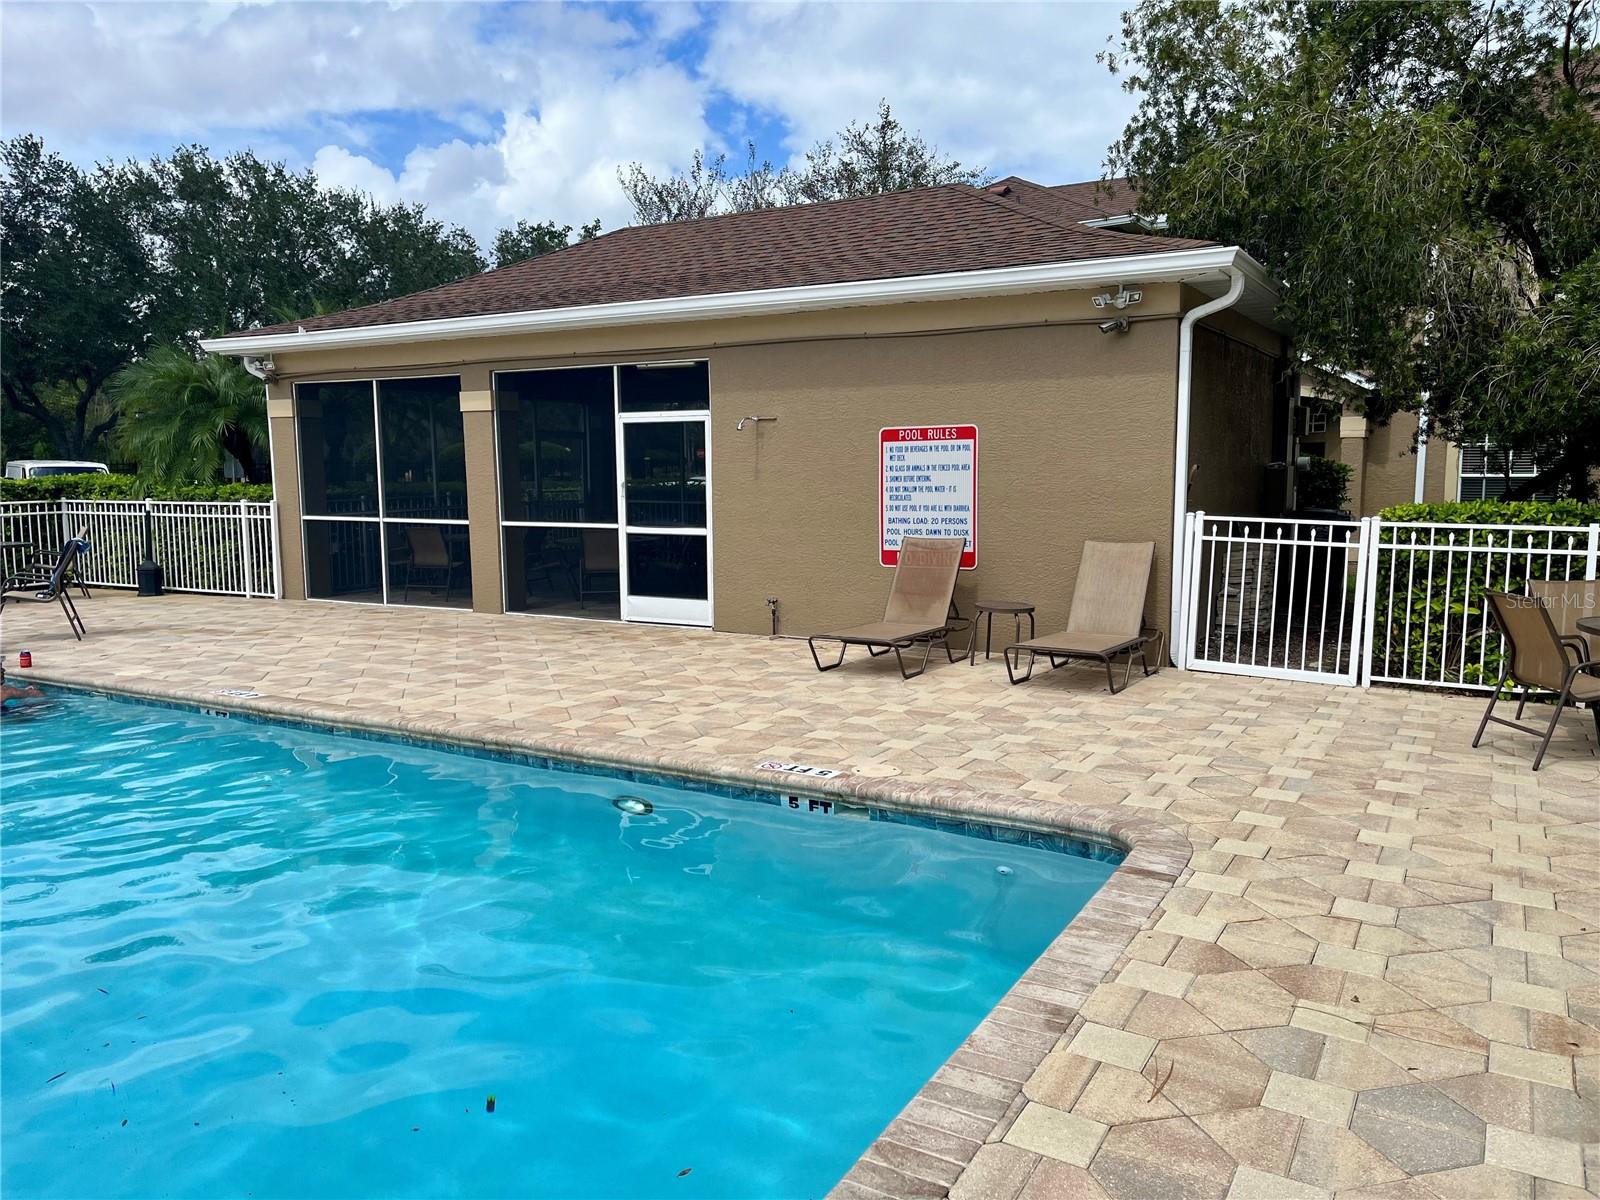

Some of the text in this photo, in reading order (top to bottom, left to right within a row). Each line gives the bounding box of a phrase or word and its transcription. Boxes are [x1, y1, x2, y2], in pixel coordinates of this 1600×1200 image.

[899, 428, 957, 440] POOL RULES
[788, 796, 832, 814] 5 FT
